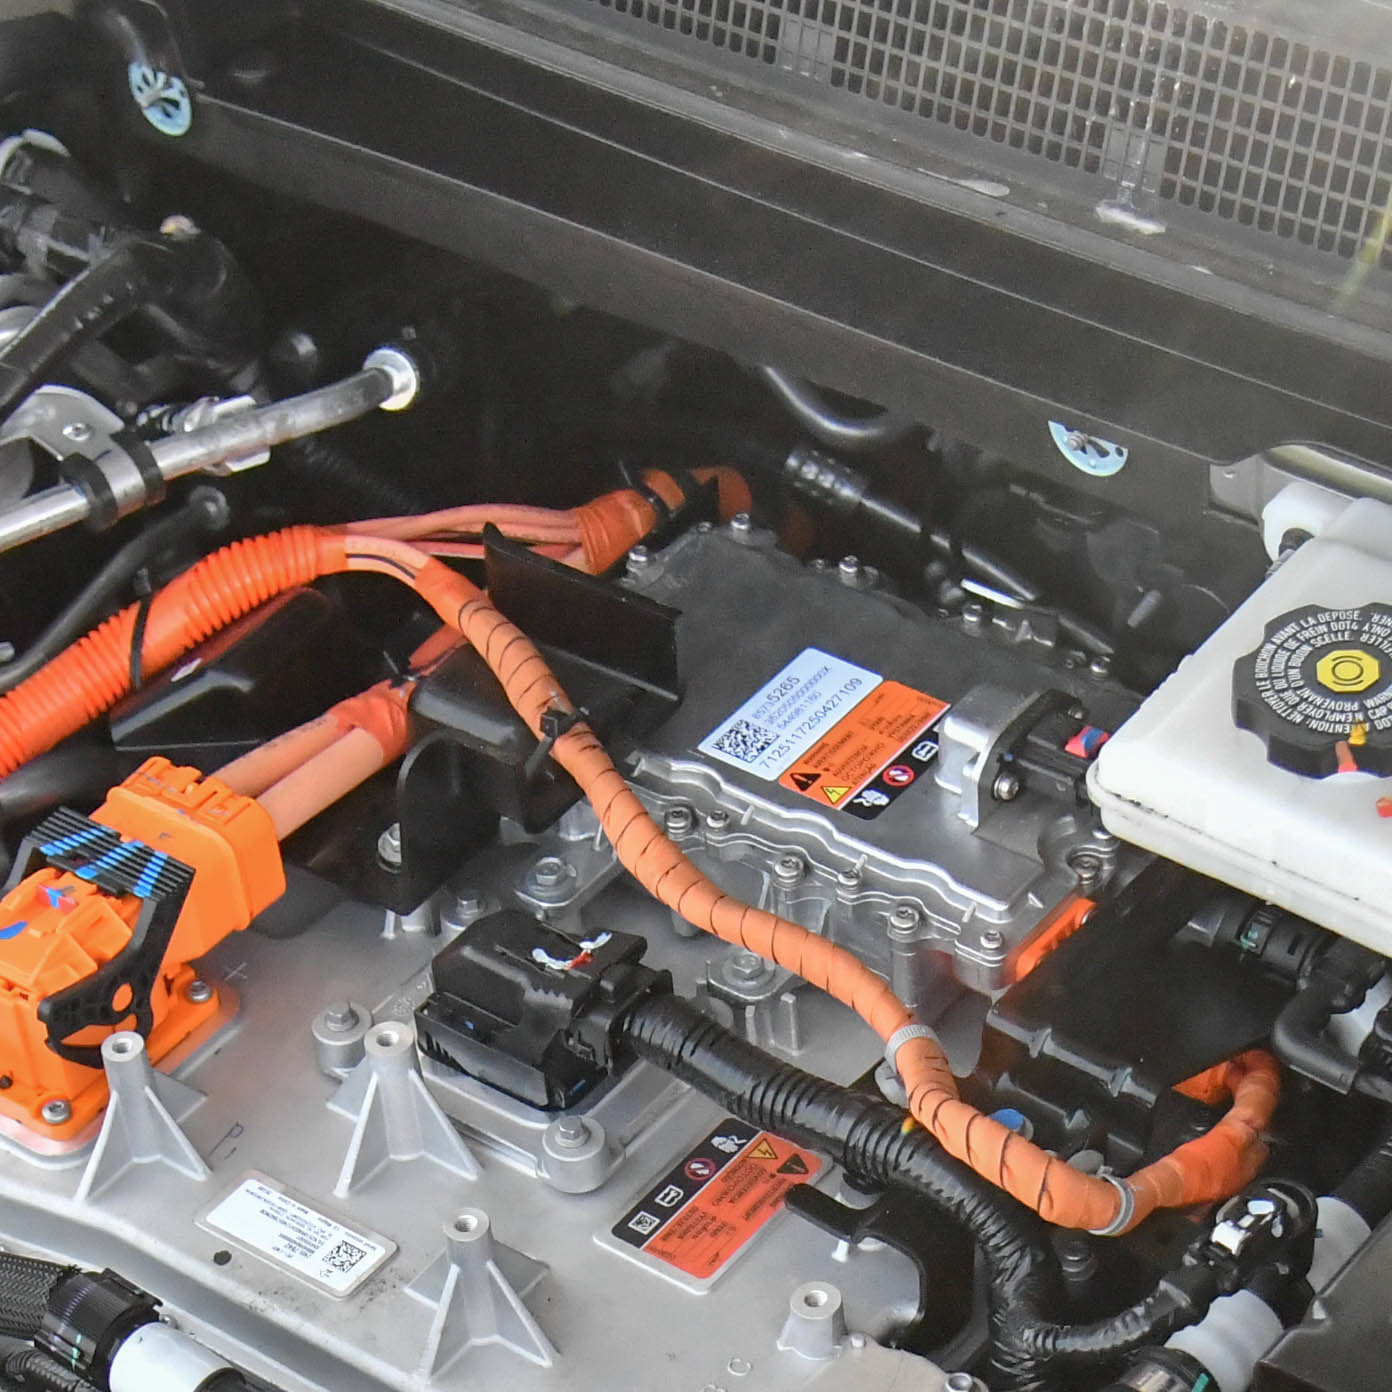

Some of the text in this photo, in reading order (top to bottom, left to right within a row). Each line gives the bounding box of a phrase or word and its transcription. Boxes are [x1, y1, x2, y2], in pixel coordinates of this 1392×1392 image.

[1300, 616, 1316, 629] LA
[1330, 621, 1359, 631] DOT4
[1361, 623, 1390, 637] ONLY
[1271, 623, 1301, 644] AVANT
[1298, 625, 1329, 642] FREIN
[1284, 636, 1299, 650] DE
[1360, 633, 1392, 653] FILLER
[1255, 643, 1277, 679] BOUCHON
[1271, 647, 1290, 672] LIQUIDE
[1288, 644, 1313, 669] BIDON
[1256, 679, 1271, 691] LE
[1272, 672, 1288, 686] DU
[1280, 686, 1297, 704] QUE
[1296, 685, 1359, 711] PROVENANT
[1261, 689, 1304, 724] NETTOYER
[1368, 705, 1388, 720] CAP
[1307, 720, 1370, 734] AENTION:
